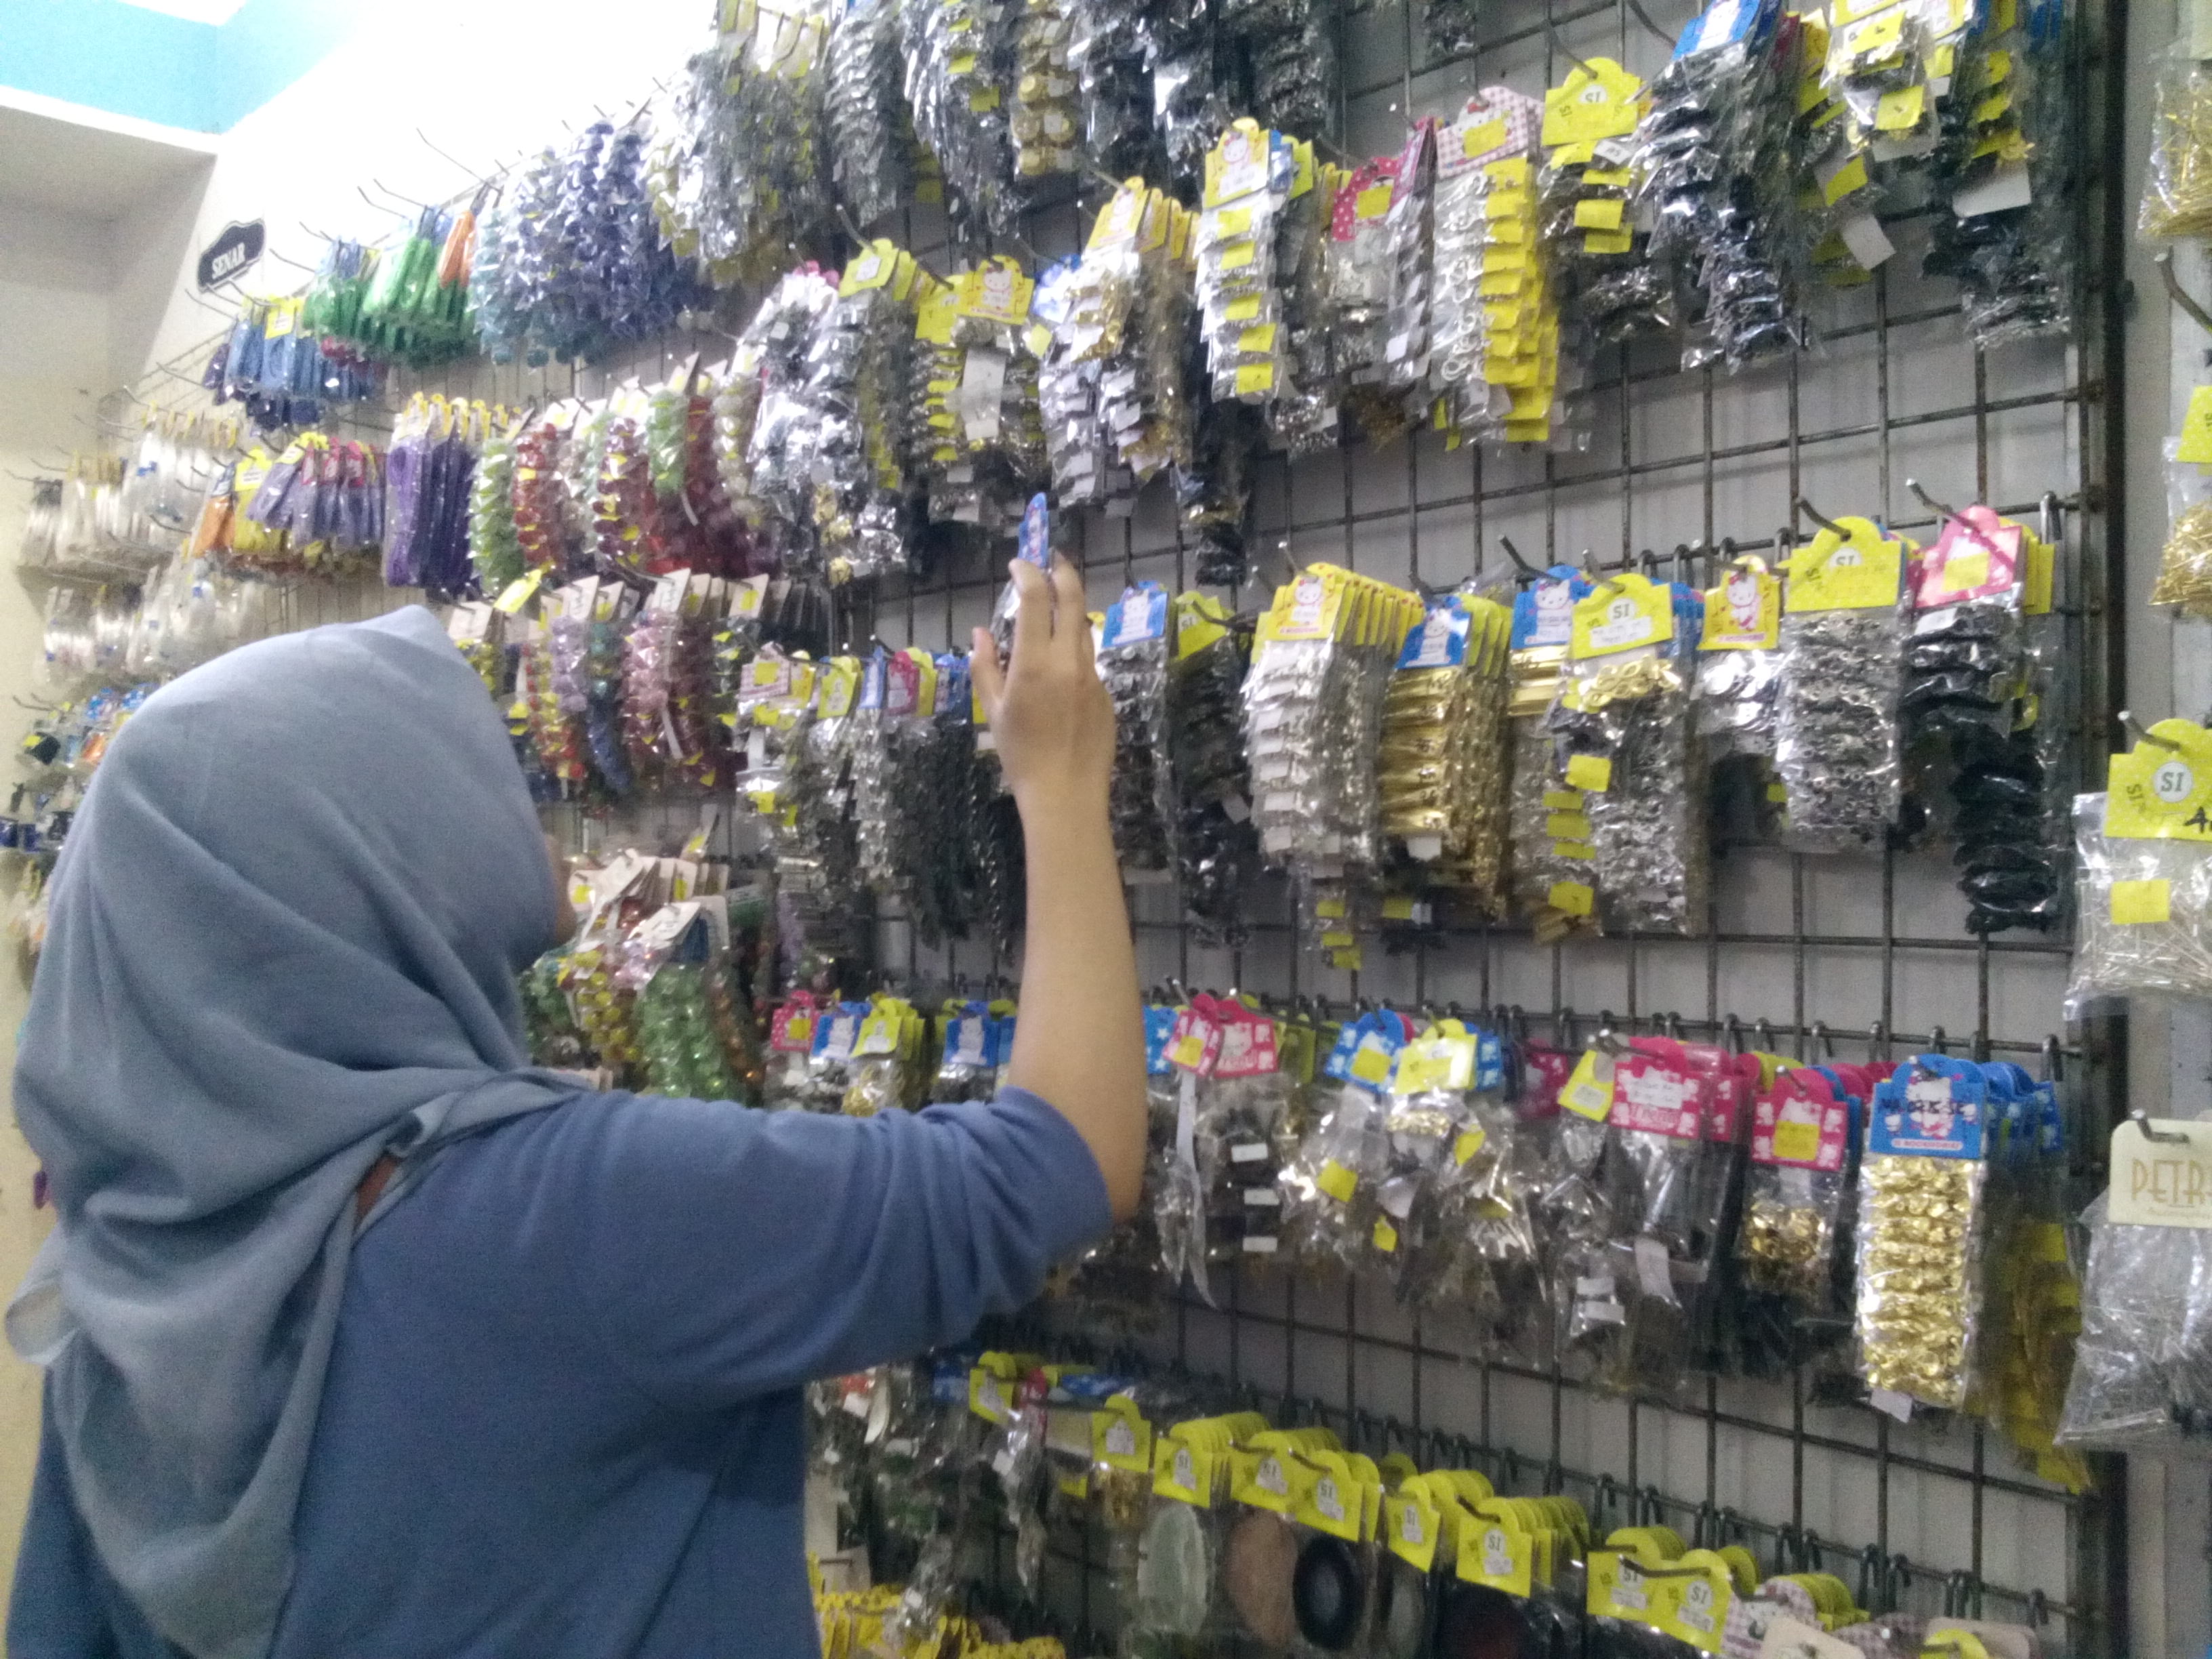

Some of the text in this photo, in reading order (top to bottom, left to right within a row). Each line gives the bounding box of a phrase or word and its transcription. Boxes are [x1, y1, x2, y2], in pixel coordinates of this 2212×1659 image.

[211, 243, 245, 280] SENAR
[1612, 602, 1631, 619] SI
[2160, 771, 2185, 792] SI
[2131, 1158, 2212, 1204] PETR
[1488, 1534, 1502, 1551] SI
[1691, 1585, 1710, 1605] SI
